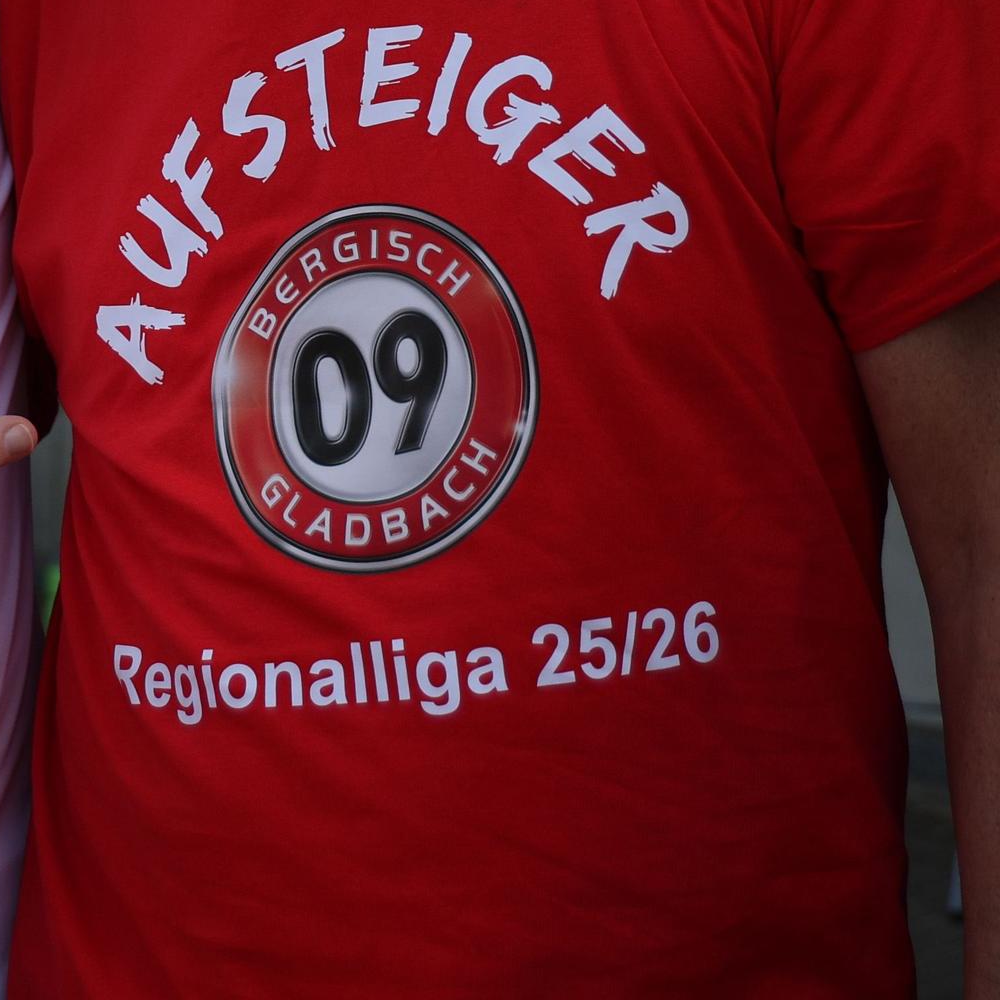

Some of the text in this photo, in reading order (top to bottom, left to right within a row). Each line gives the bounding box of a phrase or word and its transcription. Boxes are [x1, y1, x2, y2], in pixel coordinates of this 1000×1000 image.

[95, 24, 690, 386] AUFSTEIGER
[248, 229, 473, 341] BERGISCH
[291, 307, 449, 468] 09
[261, 435, 498, 547] GLADBACH
[113, 601, 722, 726] Regionalliga 25/26
